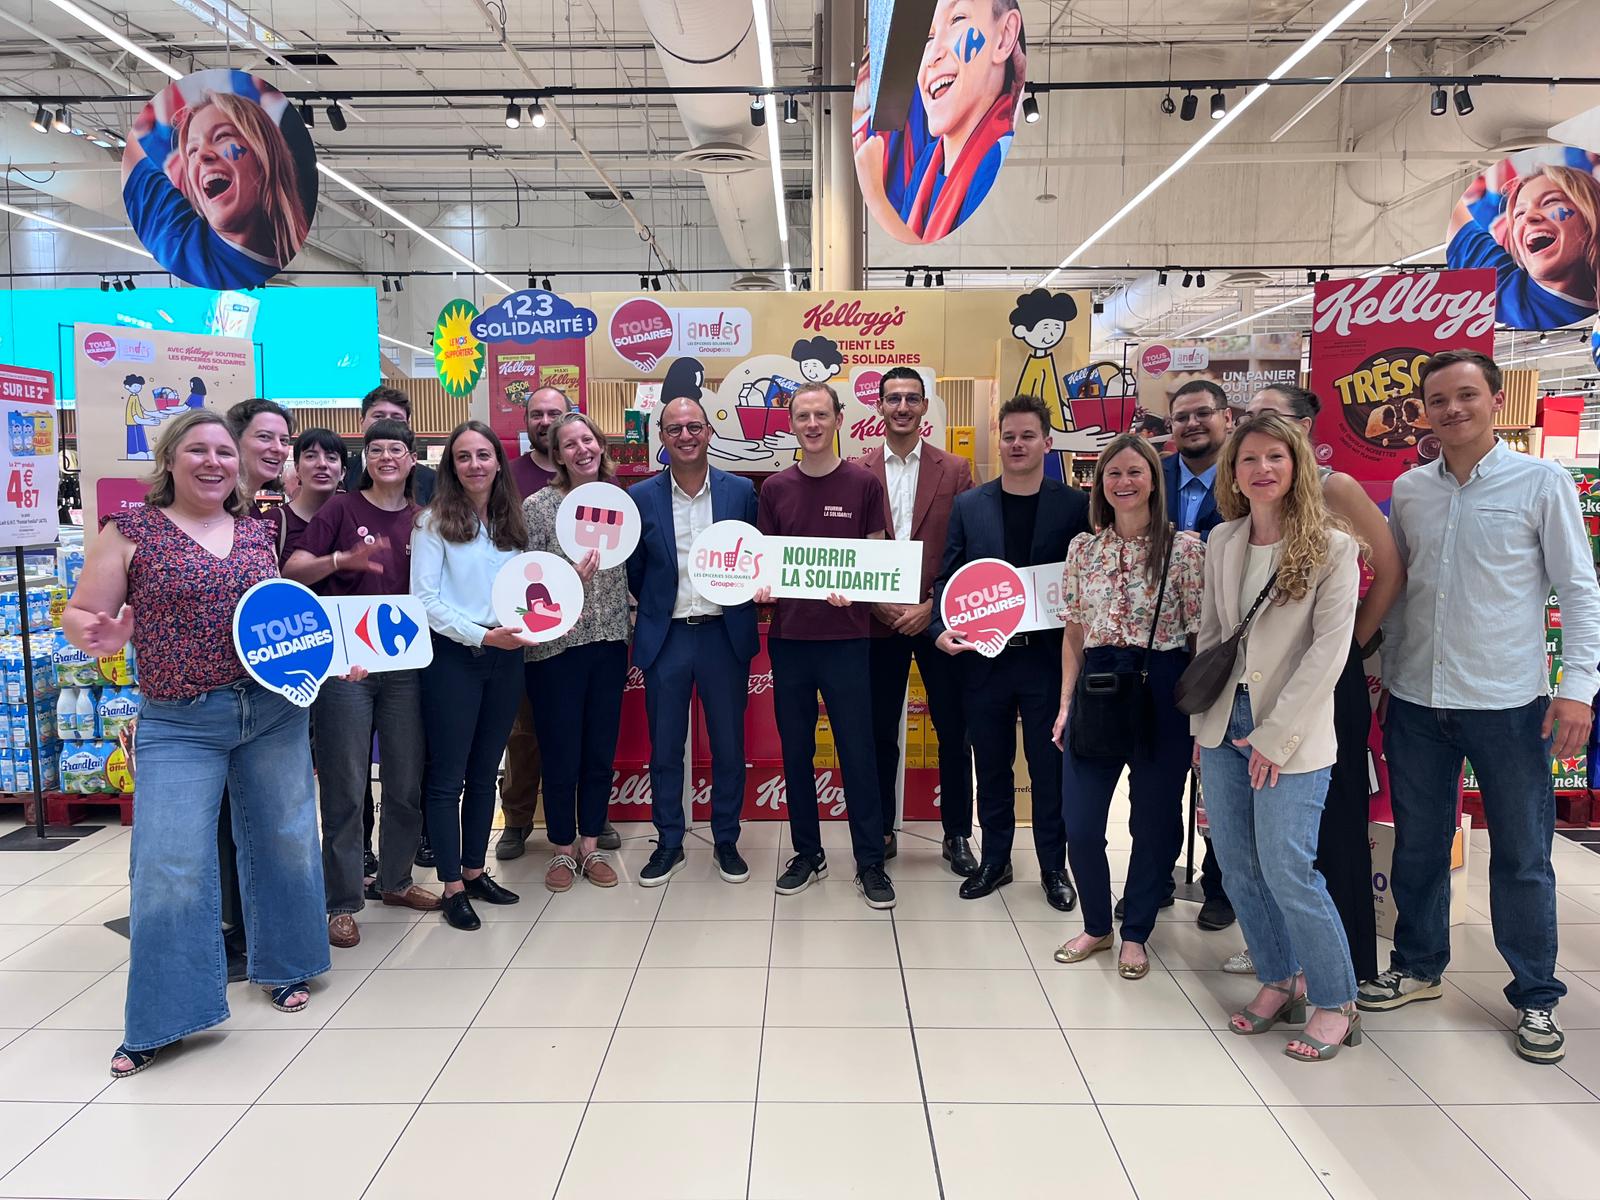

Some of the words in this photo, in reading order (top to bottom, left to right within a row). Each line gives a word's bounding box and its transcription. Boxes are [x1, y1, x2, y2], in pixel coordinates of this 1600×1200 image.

[503, 294, 553, 319] 1,2,3
[476, 315, 583, 338] SOLIDARITÉ
[619, 317, 664, 336] TOUS
[803, 299, 906, 336] Kellogg's
[615, 328, 673, 347] SOLIDAIRES
[688, 312, 741, 345] andès
[88, 341, 111, 349] TOUS
[874, 340, 895, 350] LES
[212, 358, 246, 366] SOLIDAIRES
[215, 351, 246, 359] SOUTENEZ
[852, 353, 921, 364] SOLIDAIRES
[1146, 352, 1168, 361] TOUS
[1222, 371, 1242, 382] UN
[1246, 370, 1296, 381] PANIER
[3, 382, 22, 398] SUR
[25, 384, 35, 398] LE
[24, 469, 33, 487] €
[7, 470, 23, 508] 4
[24, 489, 39, 508] 87
[120, 500, 127, 508] 2
[829, 511, 852, 519] SOLIDARITÉ
[695, 537, 763, 579] andès
[783, 546, 857, 568] NOURRIR
[781, 567, 800, 587] LA
[805, 567, 900, 591] SOLIDARITÉ
[955, 581, 1013, 611] TOUS
[949, 594, 1025, 627] SOLIDAIRES
[250, 611, 318, 646] TOUS
[246, 629, 333, 666] SOLIDAIRES
